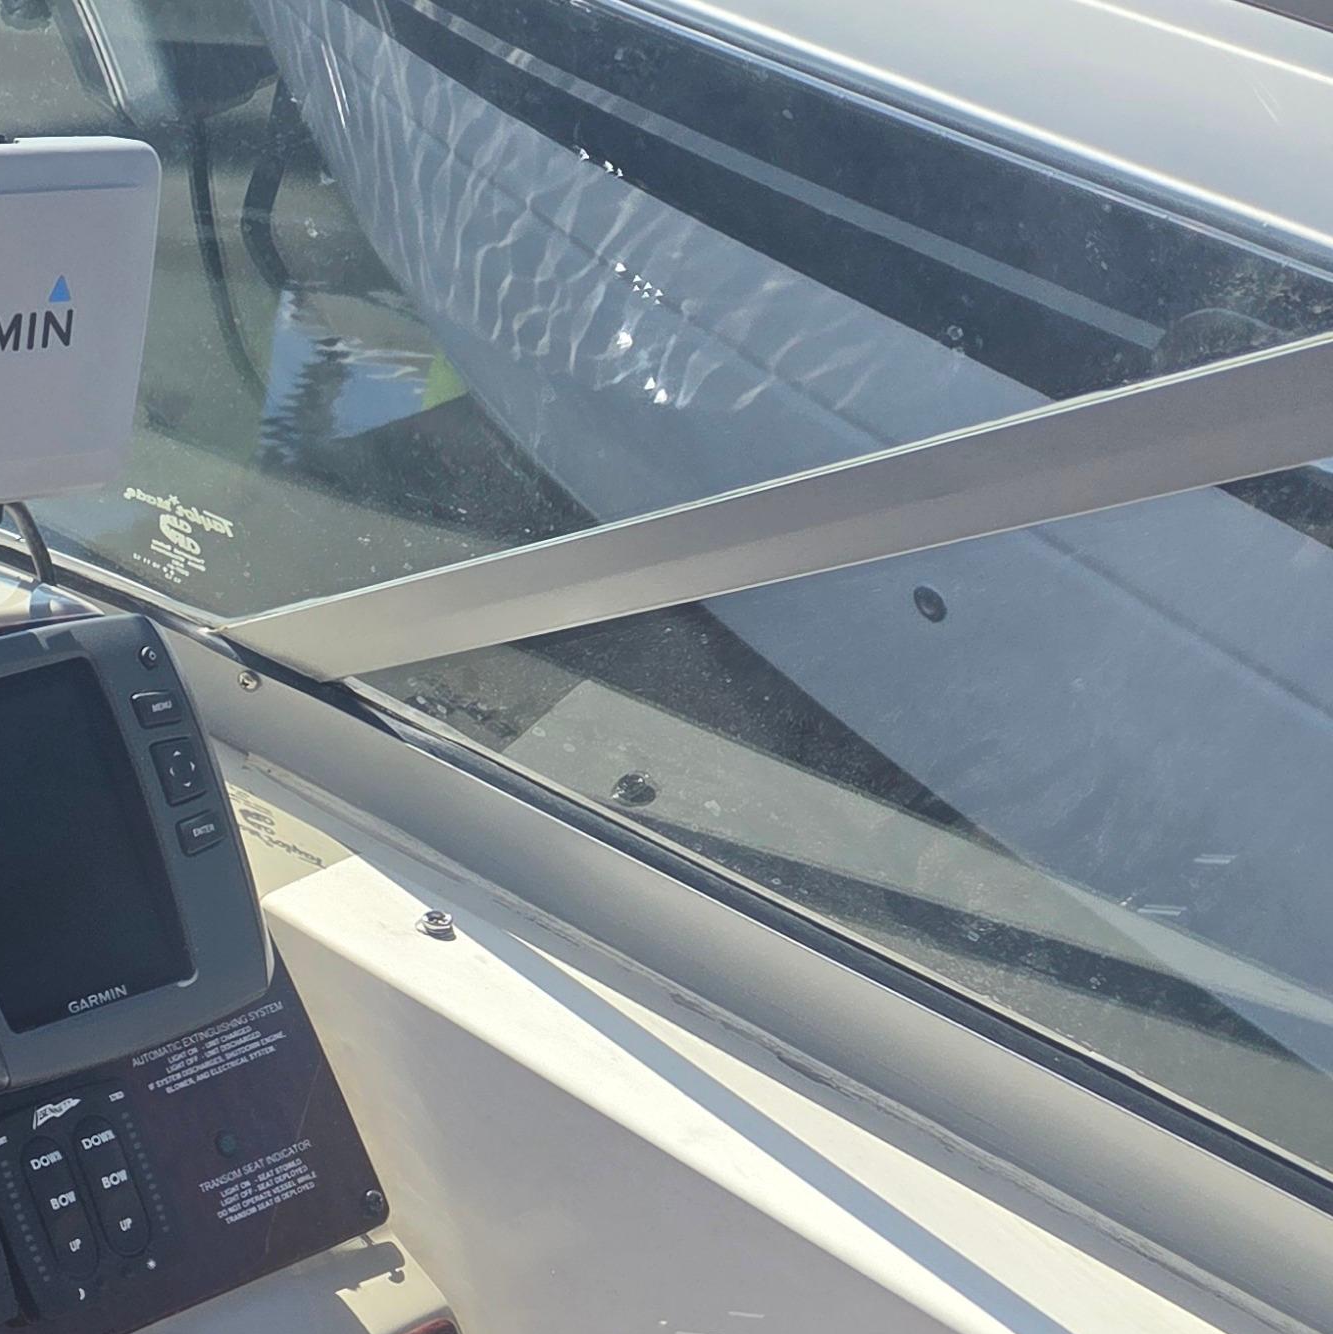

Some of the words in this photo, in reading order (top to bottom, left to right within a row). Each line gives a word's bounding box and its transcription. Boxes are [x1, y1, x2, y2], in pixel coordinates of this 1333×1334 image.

[151, 700, 173, 714] MENU
[192, 822, 216, 837] ENTER
[67, 984, 128, 1015] GARMIN
[132, 1041, 182, 1066] AUTOMATIC
[248, 1001, 283, 1020] SYSTEM
[81, 1129, 116, 1150] DOWN
[30, 1150, 63, 1171] DOWN
[199, 1168, 242, 1192] TRANSOM
[242, 1158, 264, 1175] SEAT
[266, 1139, 311, 1164] INDICATOR
[101, 1169, 128, 1189] BOW
[50, 1190, 77, 1210] BOW
[119, 1217, 133, 1232] UP
[69, 1238, 82, 1252] UP
